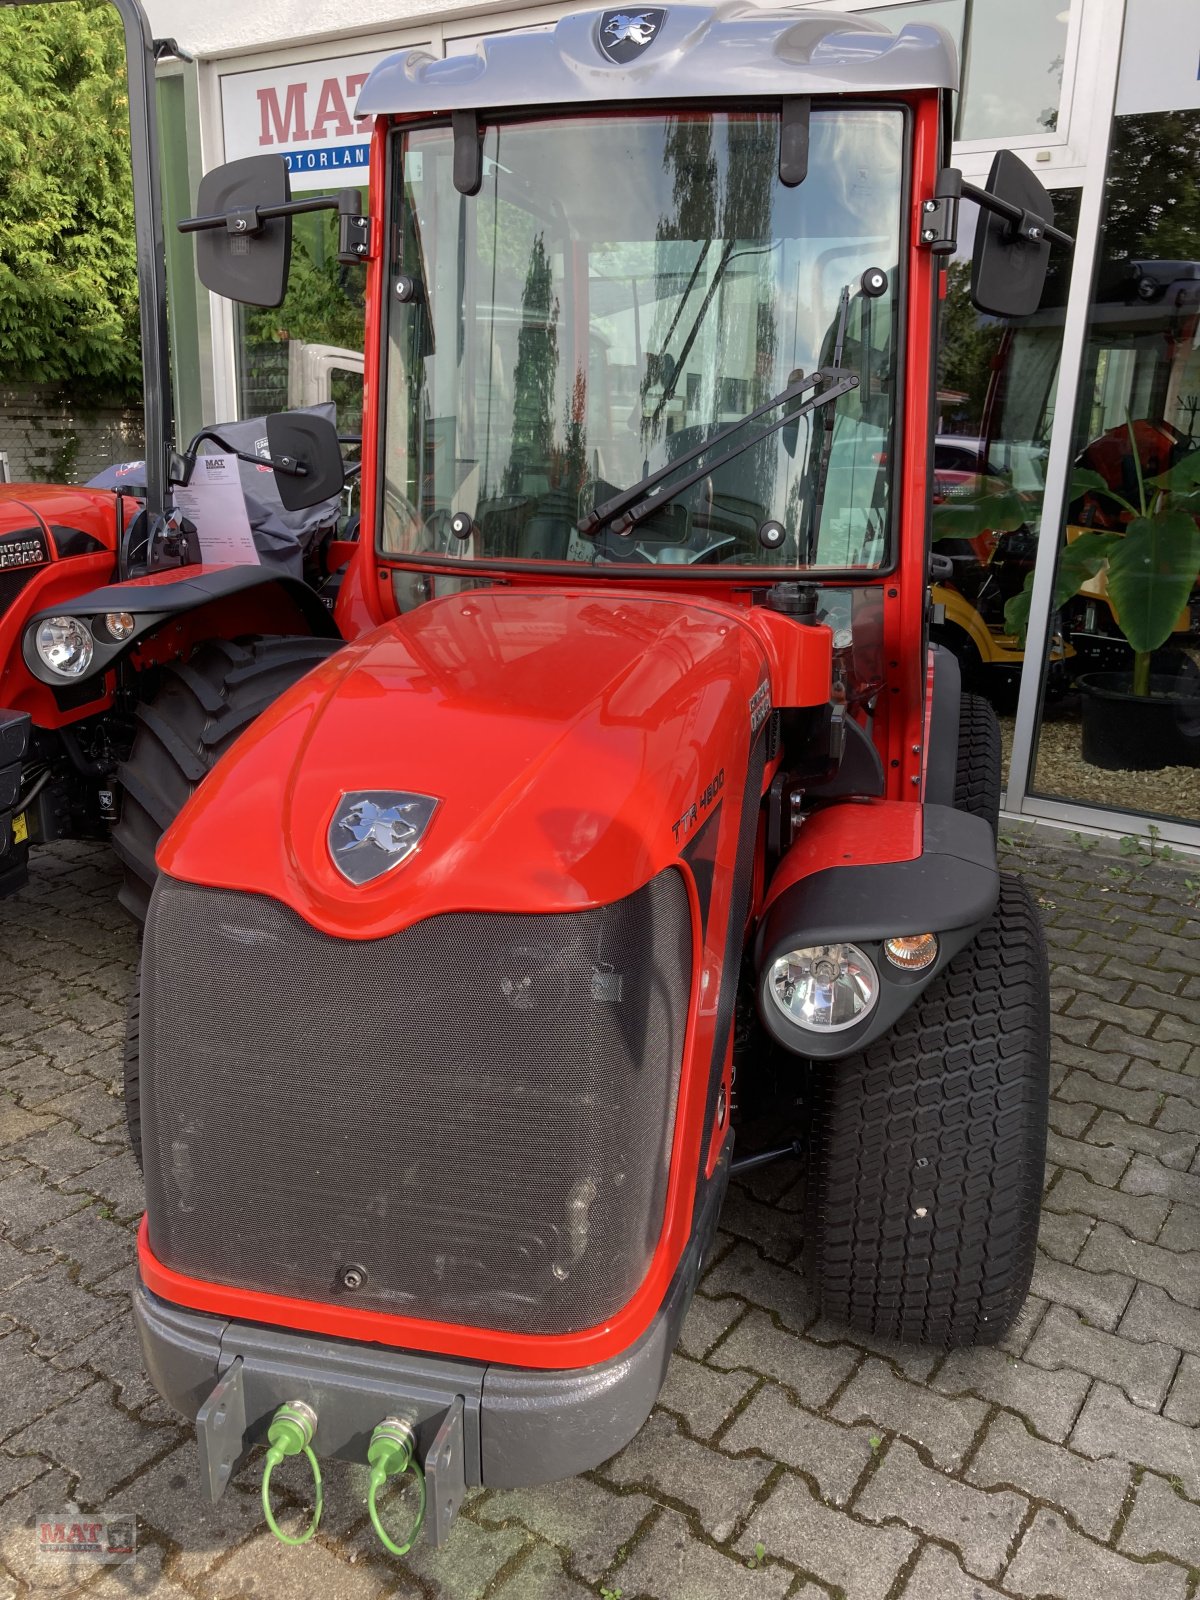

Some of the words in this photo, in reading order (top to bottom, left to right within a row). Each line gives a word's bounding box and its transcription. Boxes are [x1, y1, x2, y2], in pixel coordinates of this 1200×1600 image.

[286, 148, 370, 170] OTORLAN
[0, 540, 41, 554] NTONIO
[0, 550, 43, 567] ARRARO
[672, 802, 698, 845] TTR
